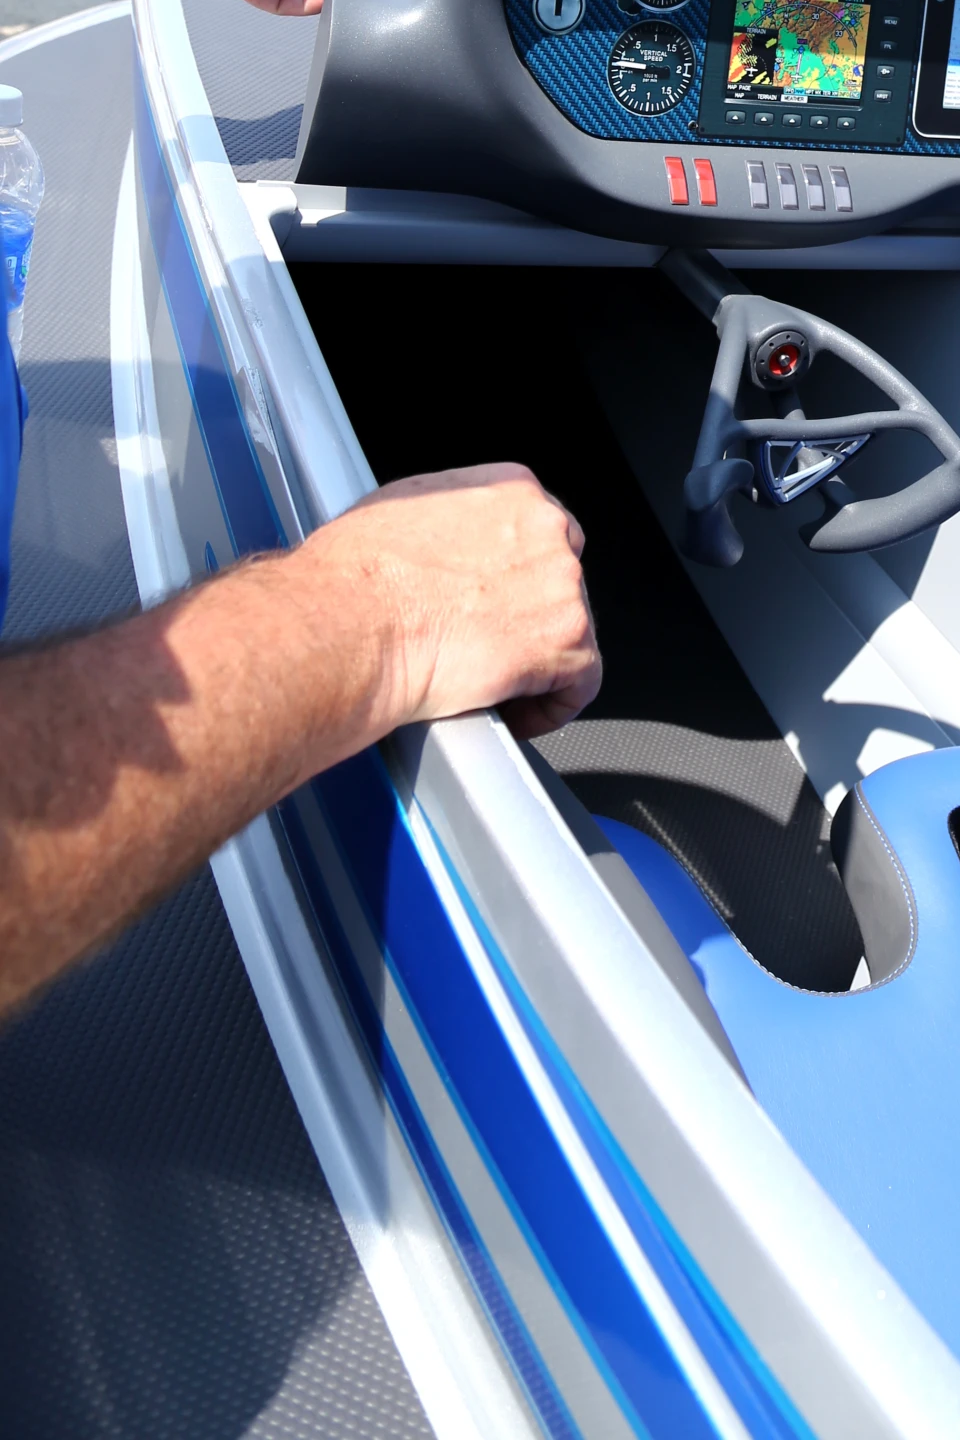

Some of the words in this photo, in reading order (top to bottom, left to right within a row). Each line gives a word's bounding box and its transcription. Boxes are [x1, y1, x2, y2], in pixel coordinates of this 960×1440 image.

[667, 44, 677, 52] 1.5
[676, 66, 682, 74] 2
[662, 87, 672, 95] 1.5
